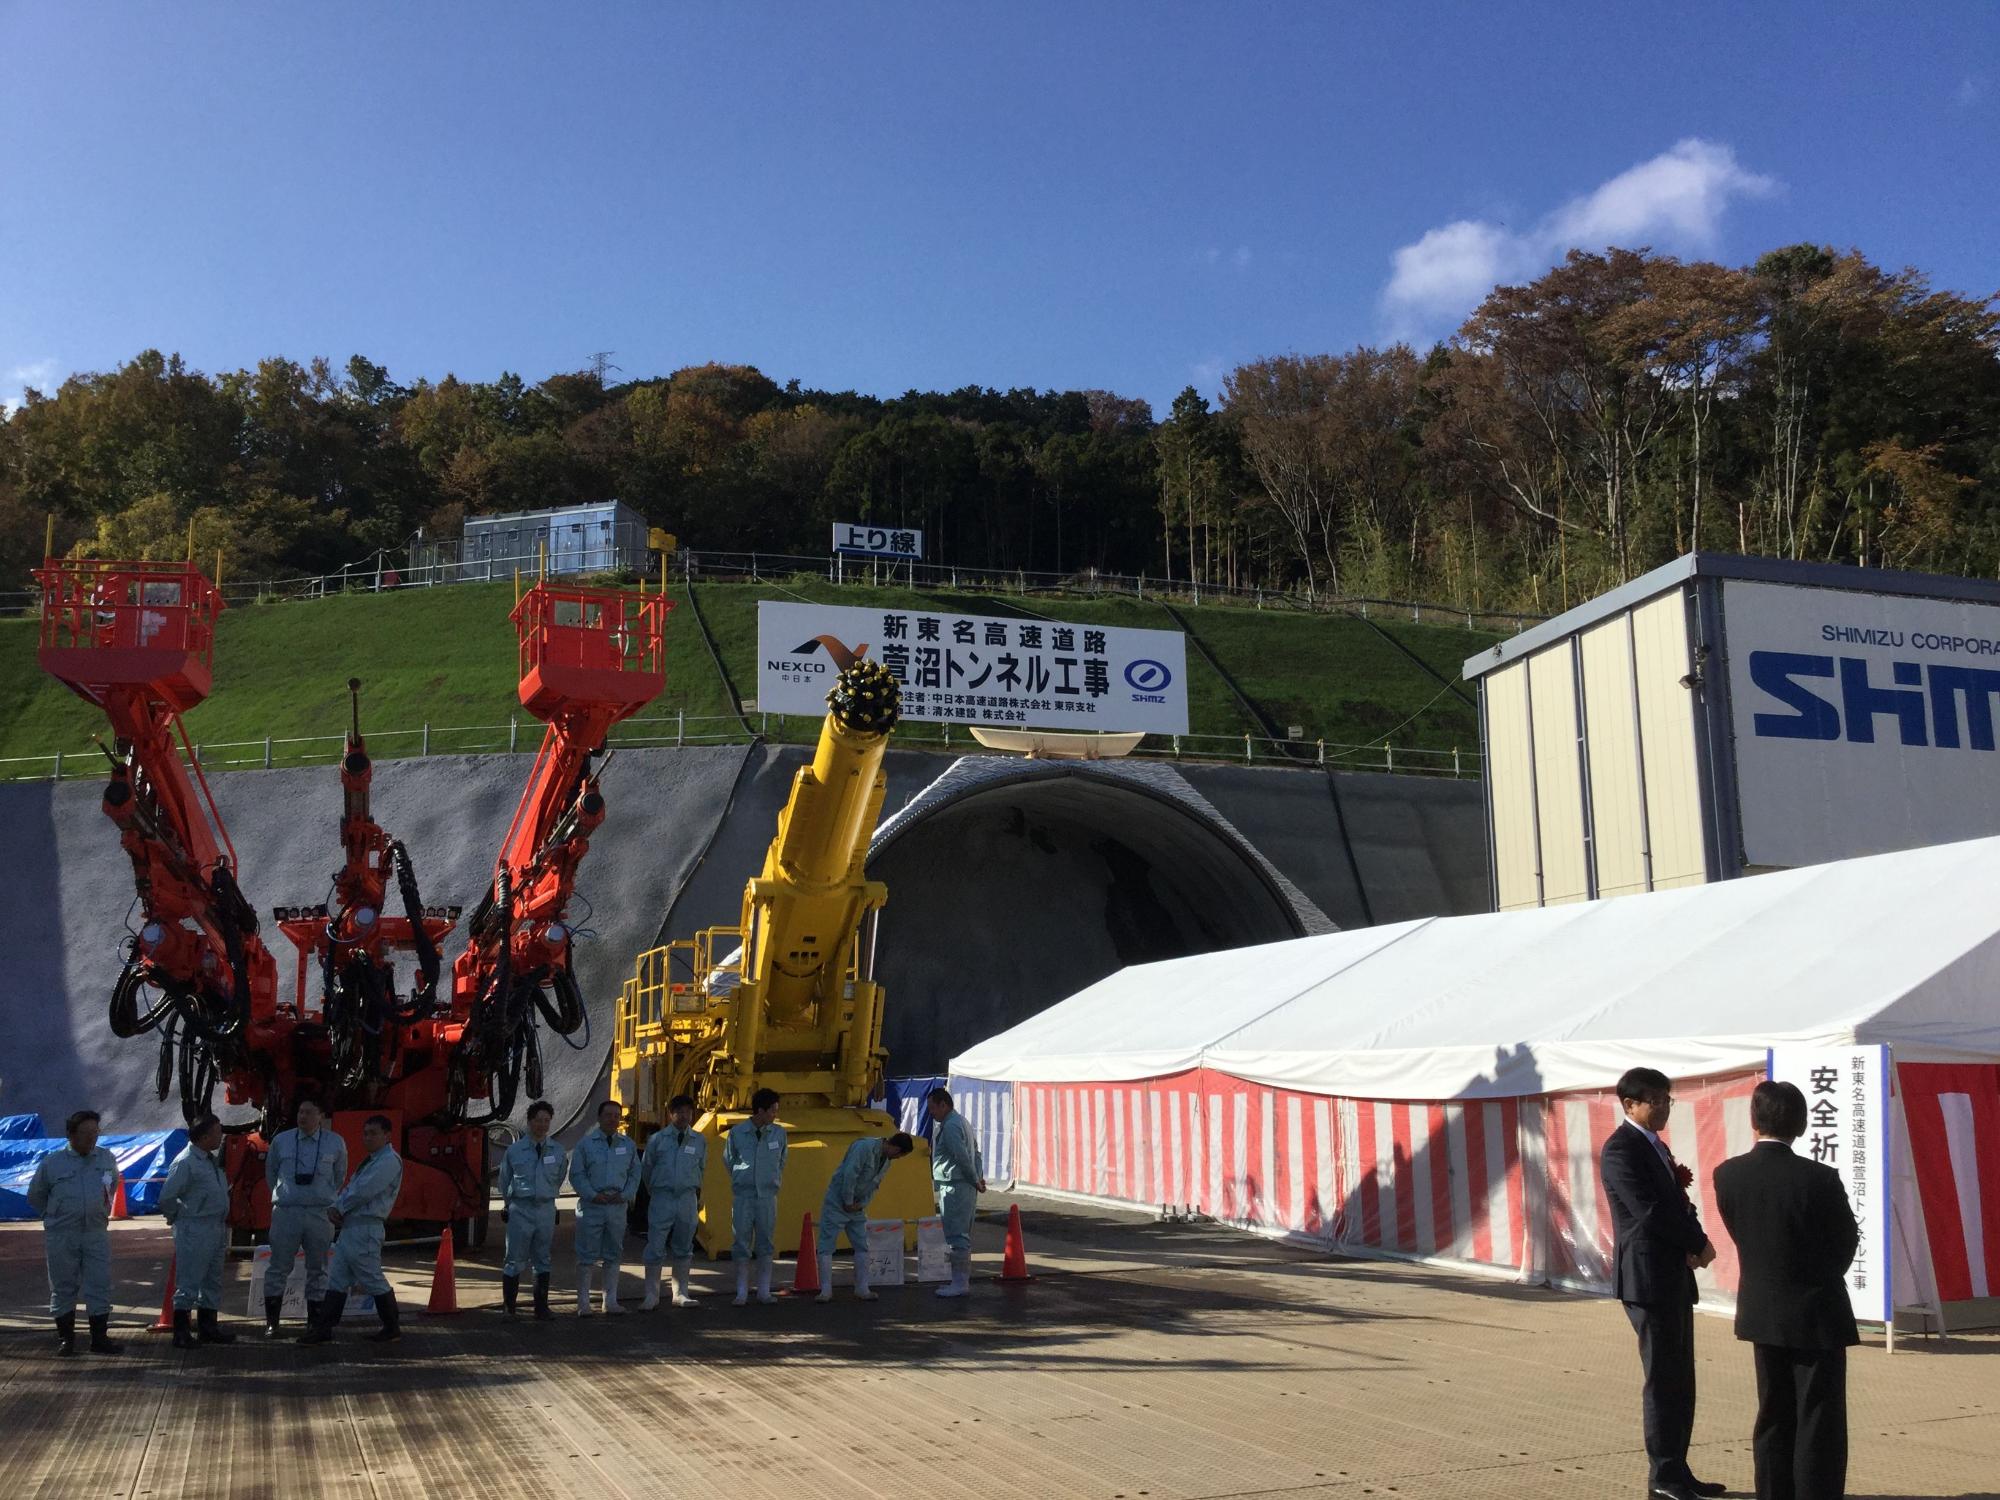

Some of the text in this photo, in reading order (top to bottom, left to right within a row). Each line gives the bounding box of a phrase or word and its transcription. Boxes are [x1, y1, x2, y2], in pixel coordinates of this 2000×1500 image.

[839, 527, 916, 553] 上り線
[883, 614, 1107, 655] 新東名高速道路
[1821, 624, 1903, 648] SHIMIZU
[767, 660, 826, 674] NEXCO
[782, 674, 812, 684] 中日本
[1054, 701, 1096, 713] 東京支社
[983, 708, 1026, 721] 株式会社
